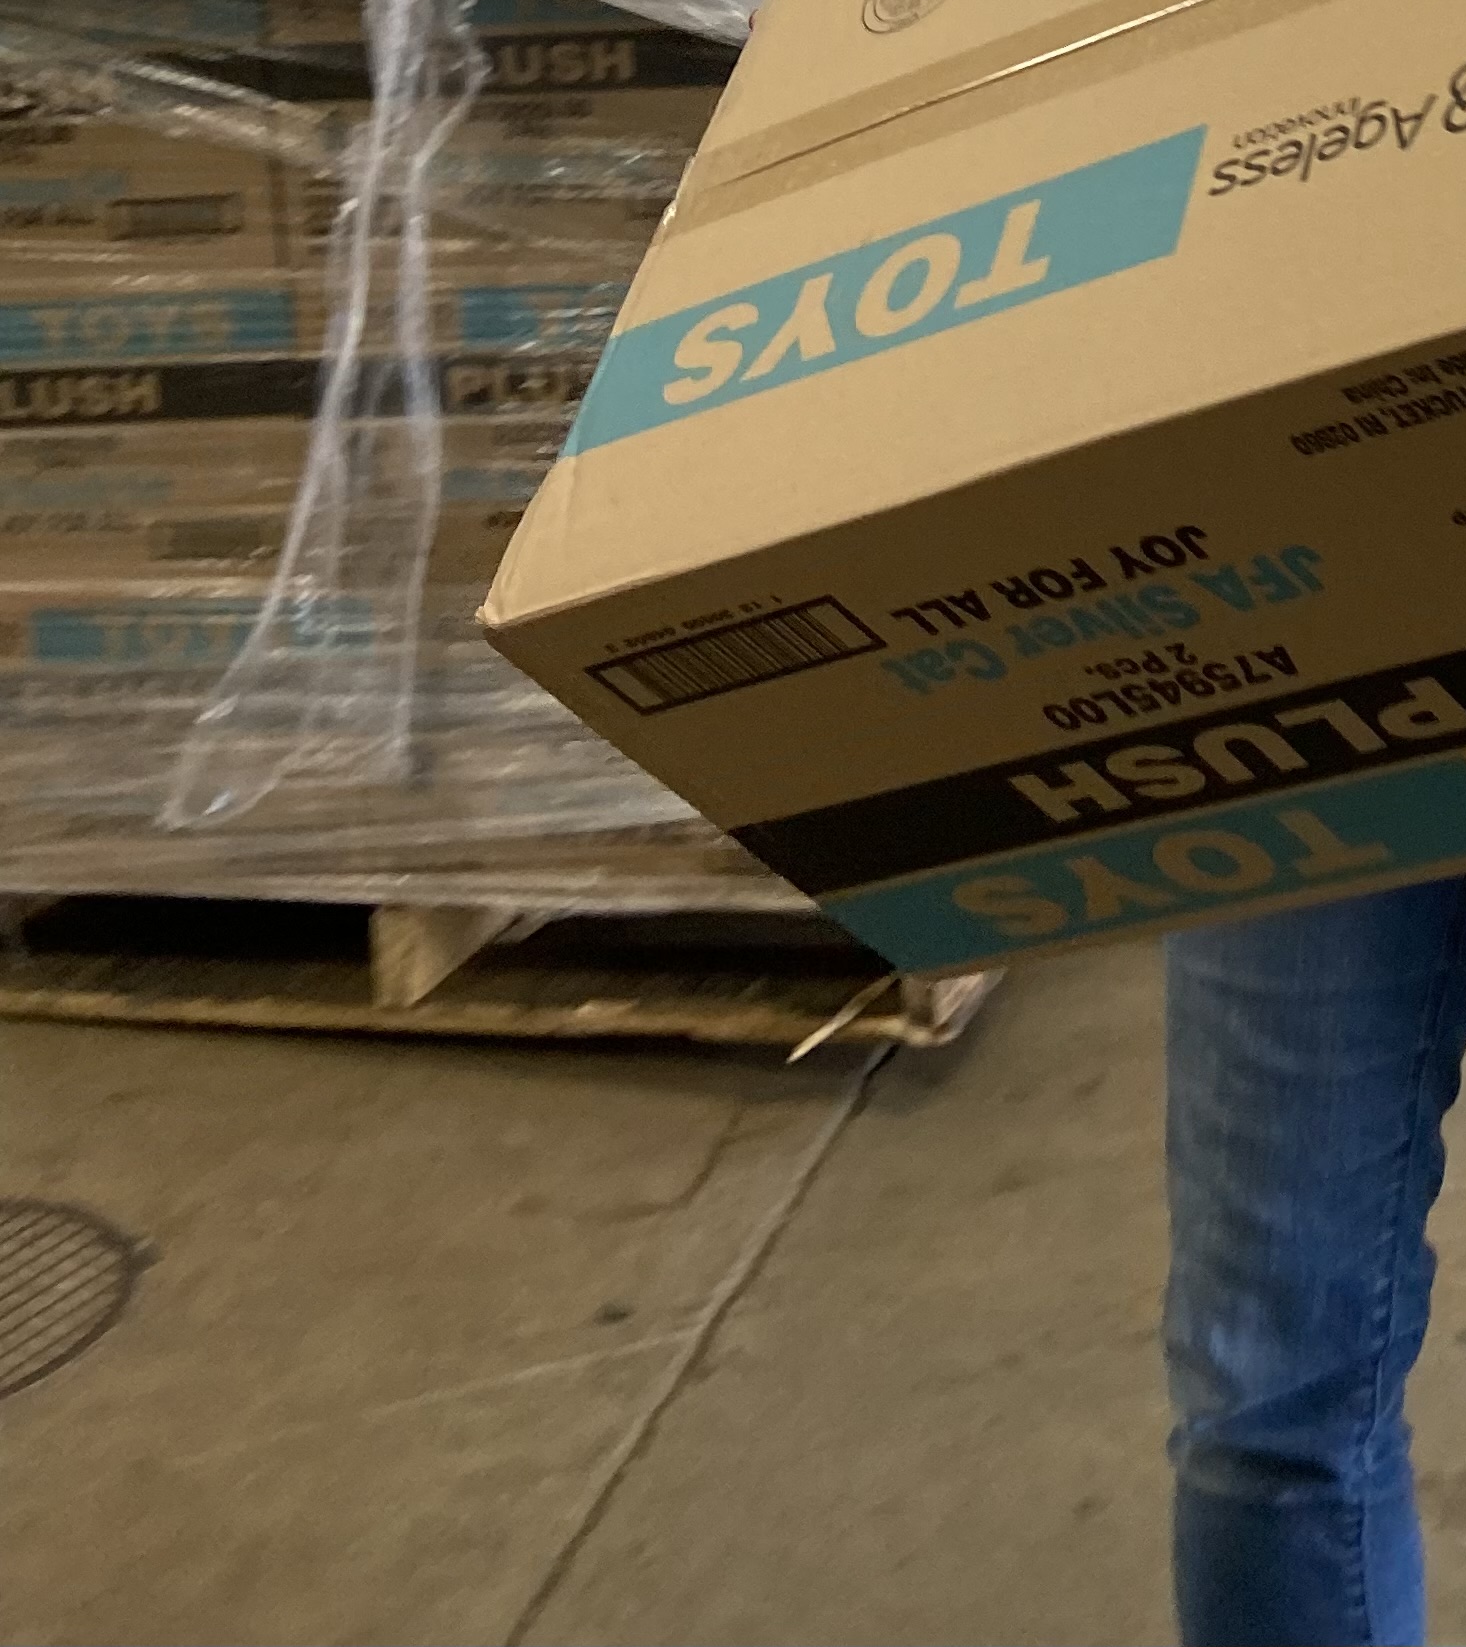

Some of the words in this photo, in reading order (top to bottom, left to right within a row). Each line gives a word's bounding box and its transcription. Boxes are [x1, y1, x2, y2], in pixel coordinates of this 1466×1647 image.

[1208, 92, 1441, 197] Ageless
[663, 198, 1051, 406] TOYS
[989, 557, 1108, 610] FOR
[1109, 524, 1209, 581] JOY
[1184, 544, 1326, 613] JFA
[888, 589, 993, 636] ALL
[1005, 583, 1202, 657] Silver
[881, 638, 1008, 696] Cat
[1042, 644, 1299, 731] A75945L00
[1164, 642, 1199, 666] 2
[951, 809, 1390, 938] TOYS
